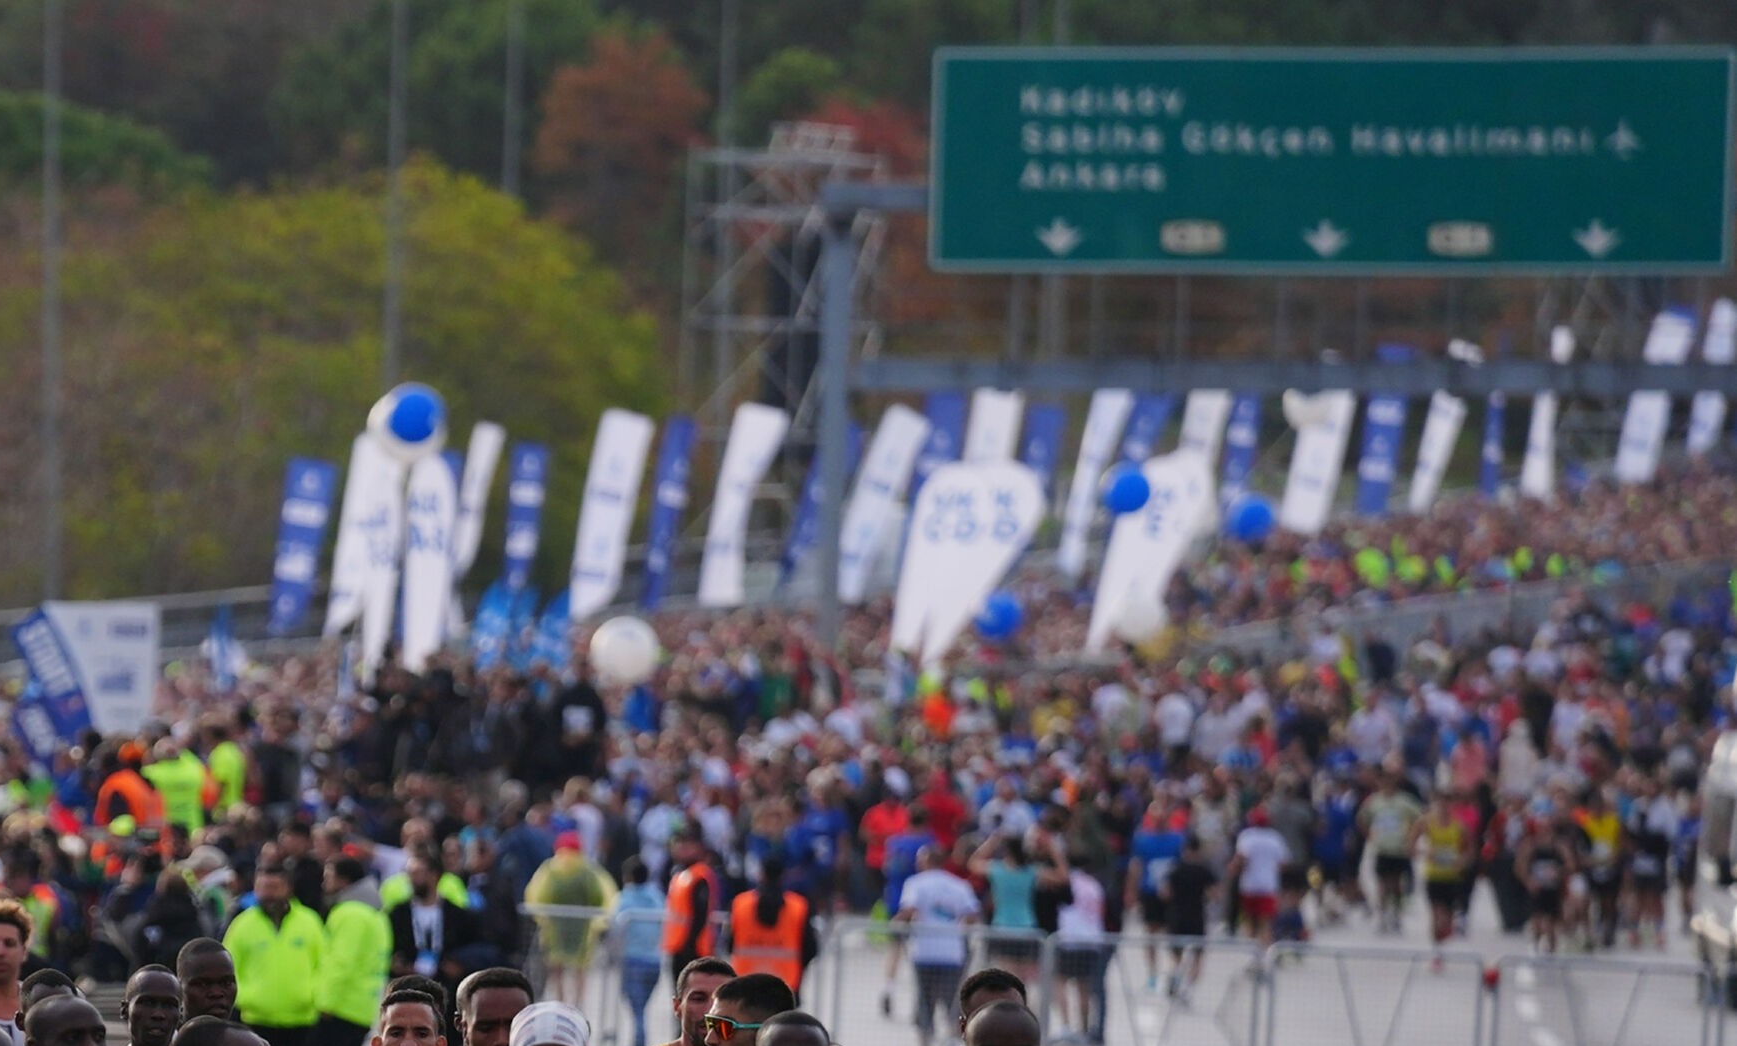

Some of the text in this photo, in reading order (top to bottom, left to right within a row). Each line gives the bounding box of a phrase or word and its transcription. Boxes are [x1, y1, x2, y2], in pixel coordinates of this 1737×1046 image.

[1021, 121, 1164, 154] Sabiha
[1181, 120, 1334, 158] Gökçen
[1019, 160, 1166, 192] Ankara
